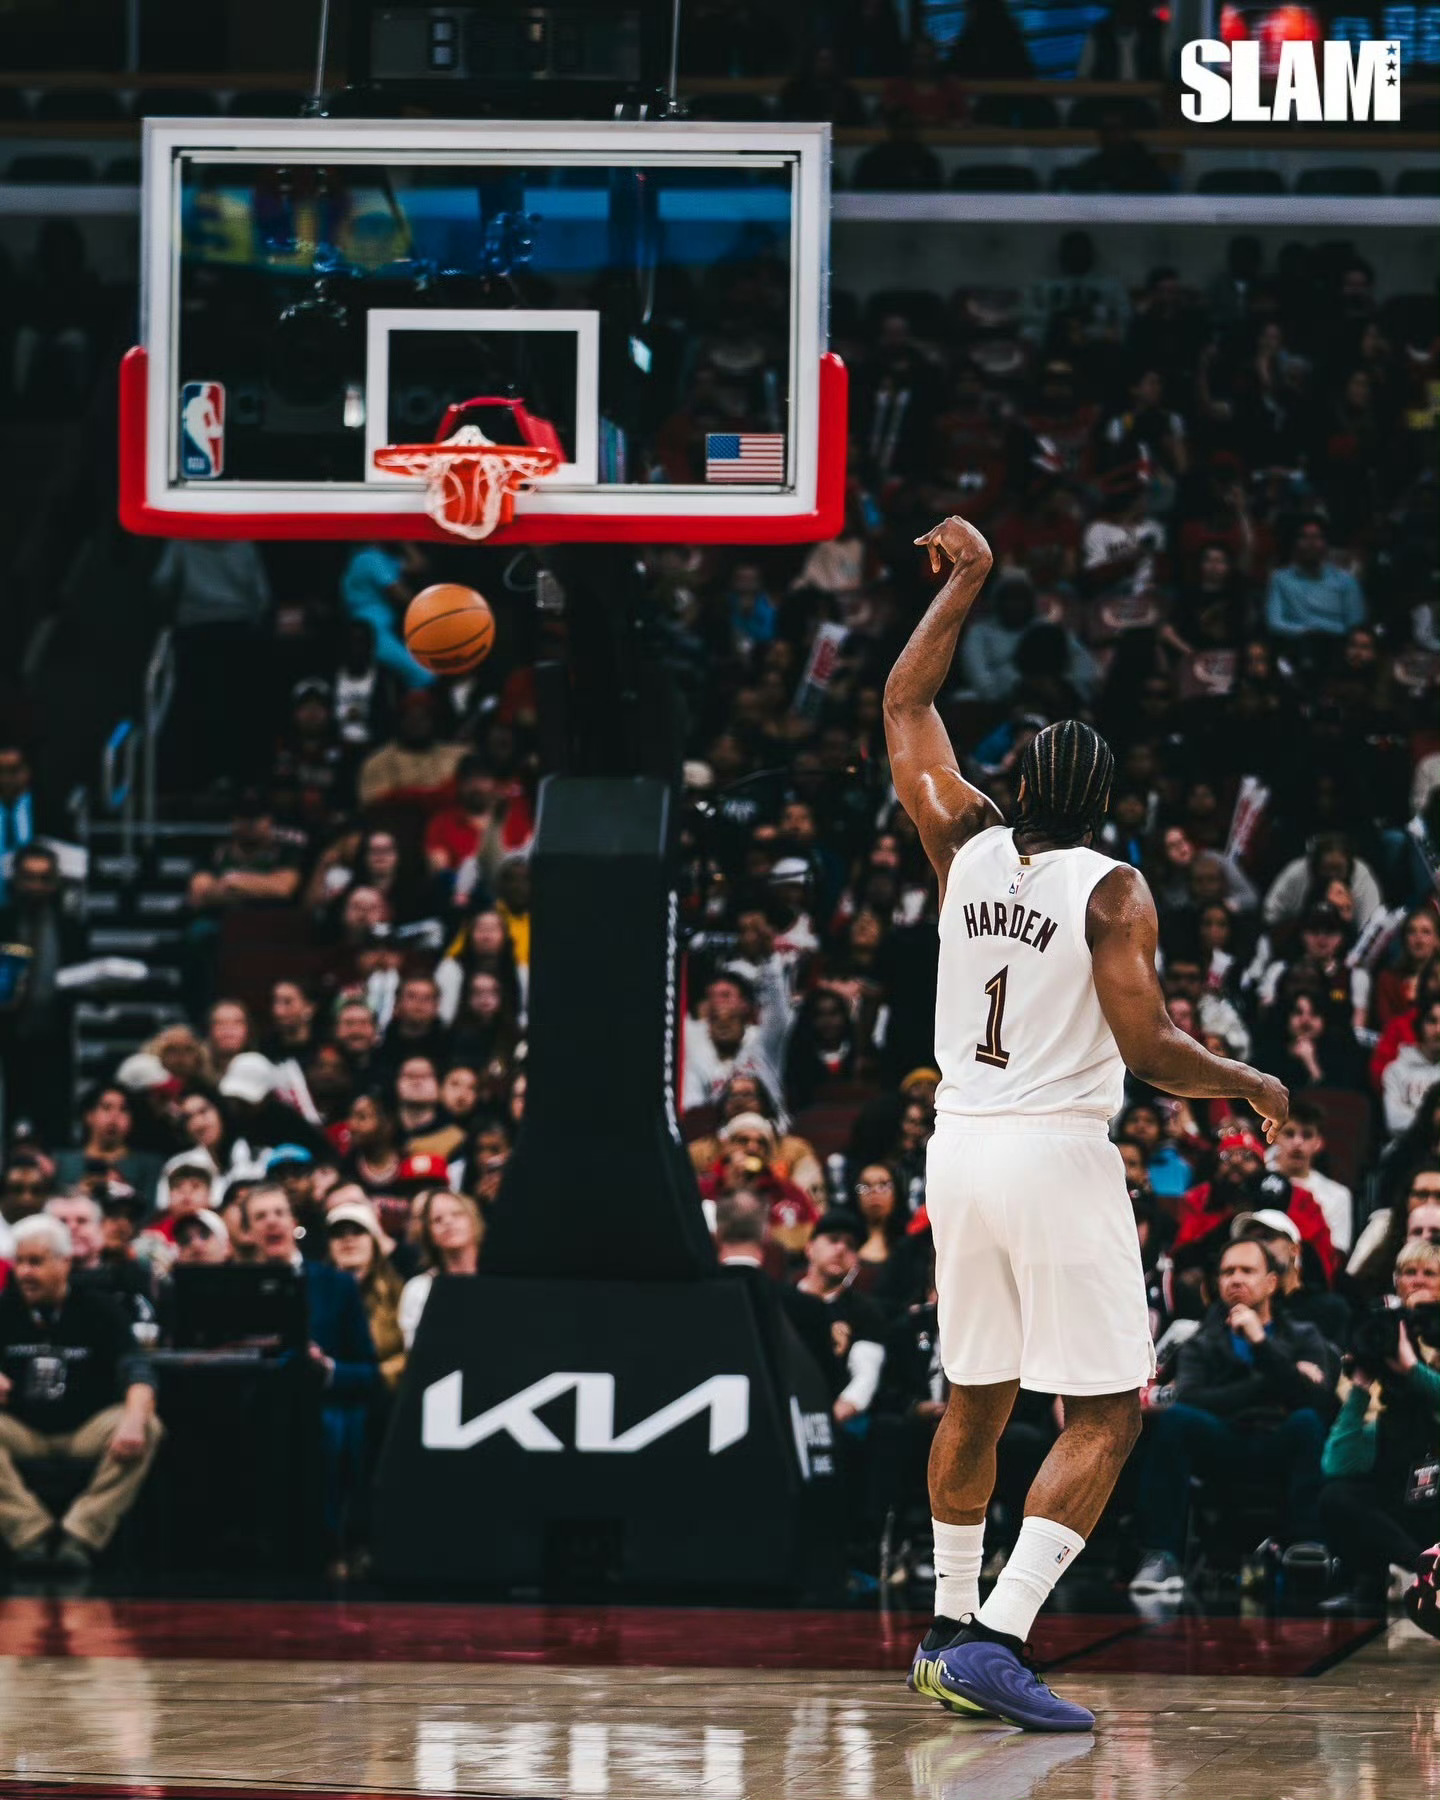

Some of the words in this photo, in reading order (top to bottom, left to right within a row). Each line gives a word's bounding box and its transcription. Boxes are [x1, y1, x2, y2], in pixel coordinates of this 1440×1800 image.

[963, 901, 1058, 953] HARDEN
[975, 965, 1010, 1070] 1
[422, 1370, 750, 1455] KIA
